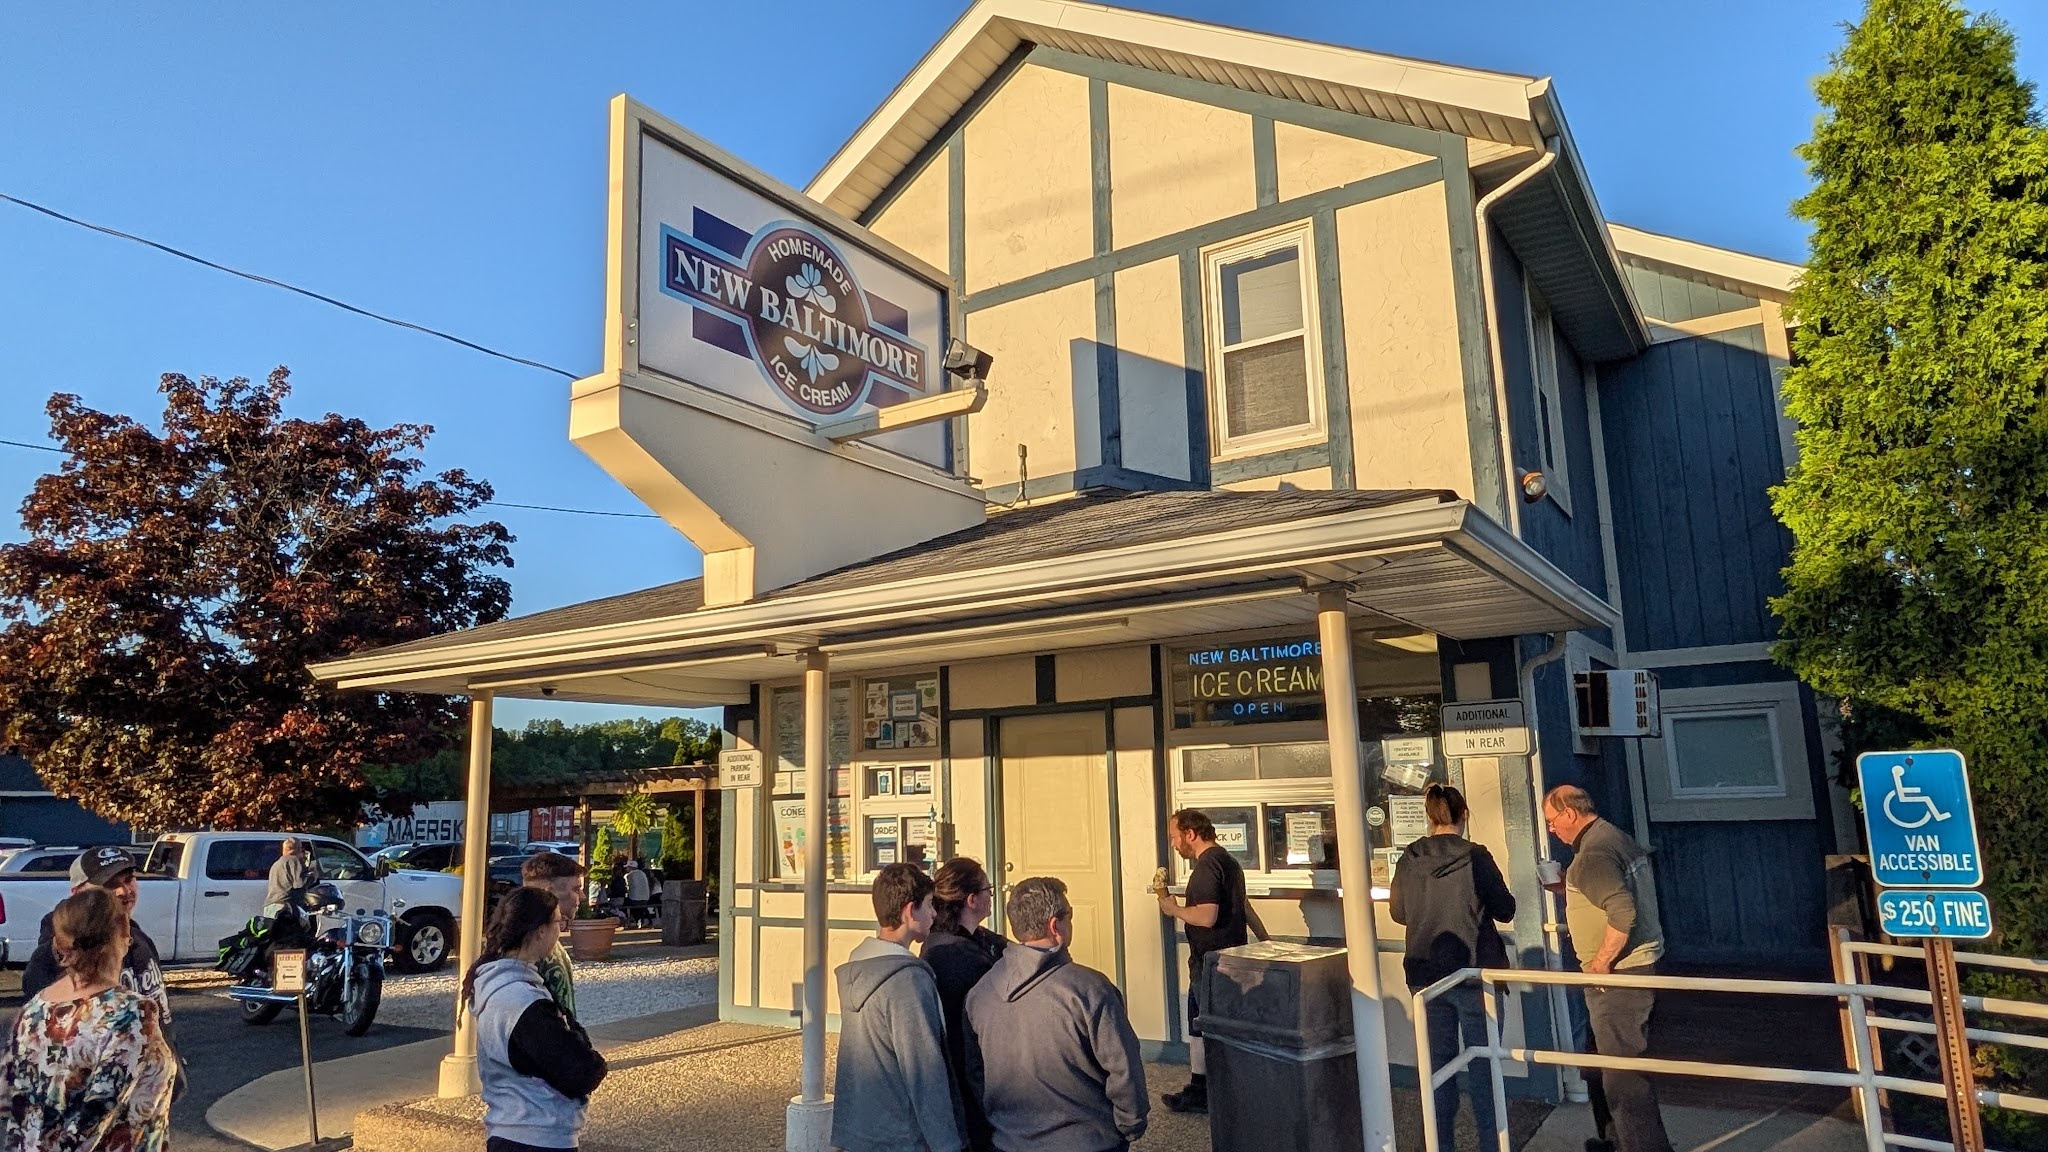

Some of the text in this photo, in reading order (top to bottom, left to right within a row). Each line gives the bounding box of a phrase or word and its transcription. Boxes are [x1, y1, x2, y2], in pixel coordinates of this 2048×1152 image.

[768, 238, 852, 296] HOMEMADE
[674, 247, 919, 383] NEW BALTIMORE
[770, 354, 851, 407] ICE CREAM
[1189, 642, 1321, 666] NEW BALTIMORE
[1193, 665, 1323, 697] ICE CREAM
[1233, 701, 1284, 715] OPEN
[1456, 708, 1511, 721] ADDITIONAL
[1464, 722, 1505, 735] PARKING
[1466, 737, 1506, 749] IN REAR
[727, 754, 754, 762] ADDITIONAL
[730, 764, 751, 772] PARKING
[730, 773, 751, 782] IN REAR
[387, 819, 465, 842] MAERSK
[874, 825, 898, 835] ORDER
[1216, 832, 1242, 842] CK UP
[1904, 834, 1940, 852] VAN
[1879, 853, 1975, 871] ACCESSIBLE
[1943, 901, 1987, 928] FINE
